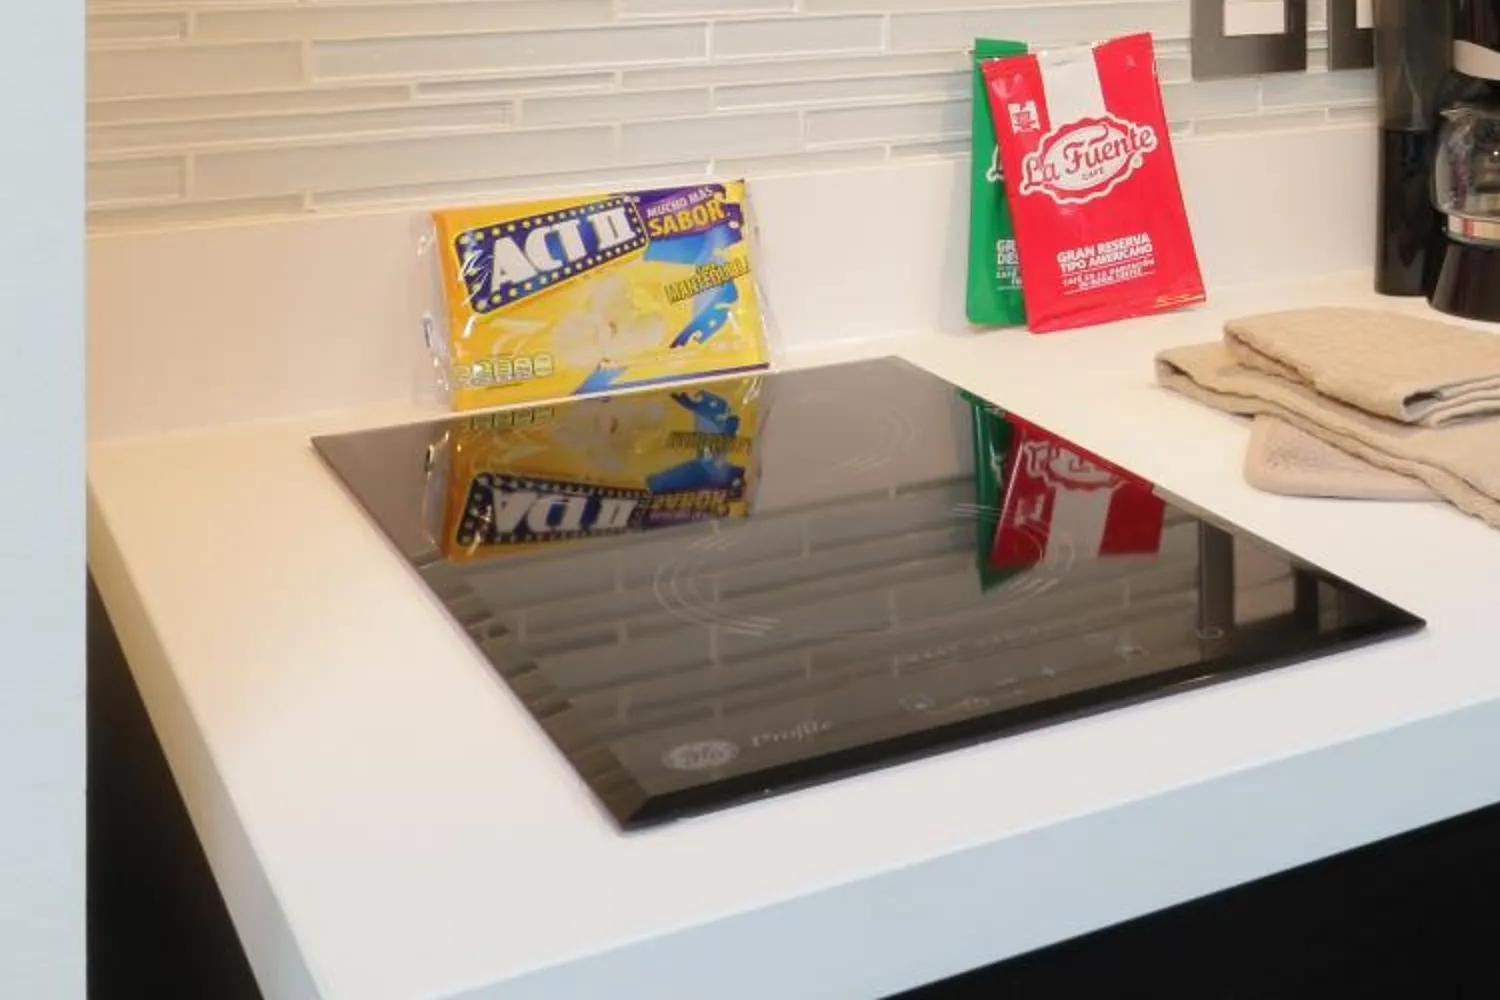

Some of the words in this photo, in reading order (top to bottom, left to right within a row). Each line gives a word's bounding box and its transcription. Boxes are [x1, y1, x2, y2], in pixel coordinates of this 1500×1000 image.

[1023, 157, 1061, 190] La
[1063, 123, 1155, 175] Fuente
[647, 199, 726, 237] SABOR
[490, 219, 589, 293] ACT
[1056, 244, 1096, 263] GRAN
[1096, 232, 1152, 254] RESERVA
[1059, 257, 1087, 273] TIPO
[1088, 243, 1153, 267] AMERICANO
